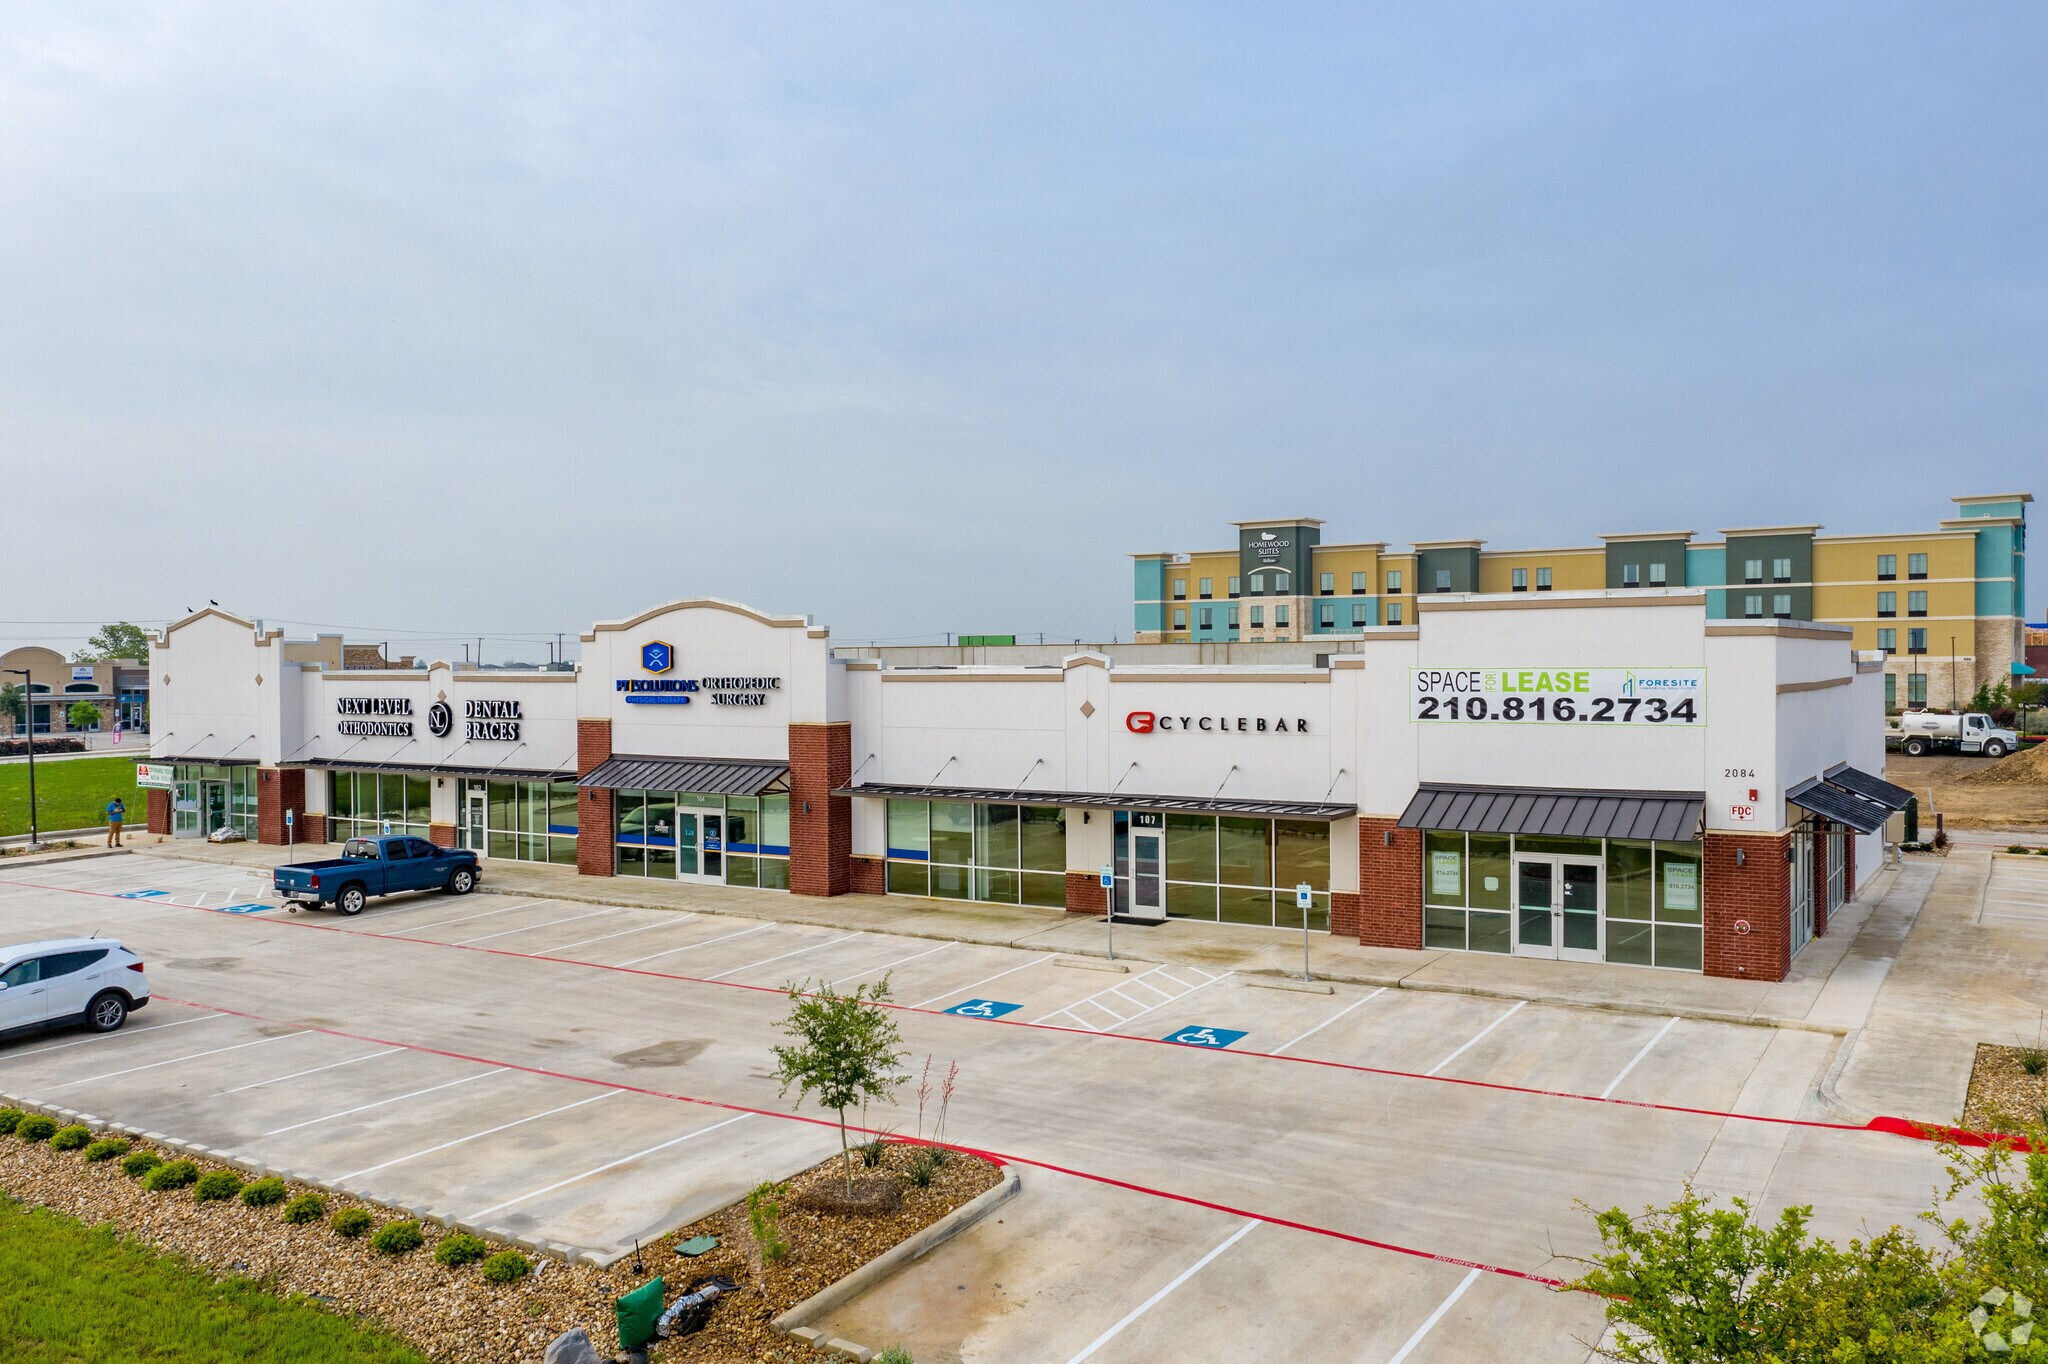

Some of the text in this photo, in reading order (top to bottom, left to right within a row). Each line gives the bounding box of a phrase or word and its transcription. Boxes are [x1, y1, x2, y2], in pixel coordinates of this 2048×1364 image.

[1248, 540, 1290, 549] HOMEWOOD
[1258, 547, 1280, 555] SUITES
[633, 679, 700, 693] SOLUTIONS
[700, 677, 781, 690] ORTHOPEDIC
[1417, 671, 1590, 693] SPACE FOR LEASE
[1638, 679, 1697, 687] FORESITE
[627, 696, 656, 704] PHYSICAL
[710, 693, 766, 706] SURGERY
[337, 698, 411, 716] NEXT LEVEL
[464, 700, 521, 719] DENTAL
[1417, 696, 1698, 723] 210.816.2734
[337, 721, 413, 736] ORTHODONTICS
[1159, 716, 1308, 732] CYCLEBAR
[465, 722, 520, 740] BRACES
[1724, 768, 1755, 778] 2084
[1731, 806, 1752, 816] FDC
[1140, 815, 1156, 825] 107
